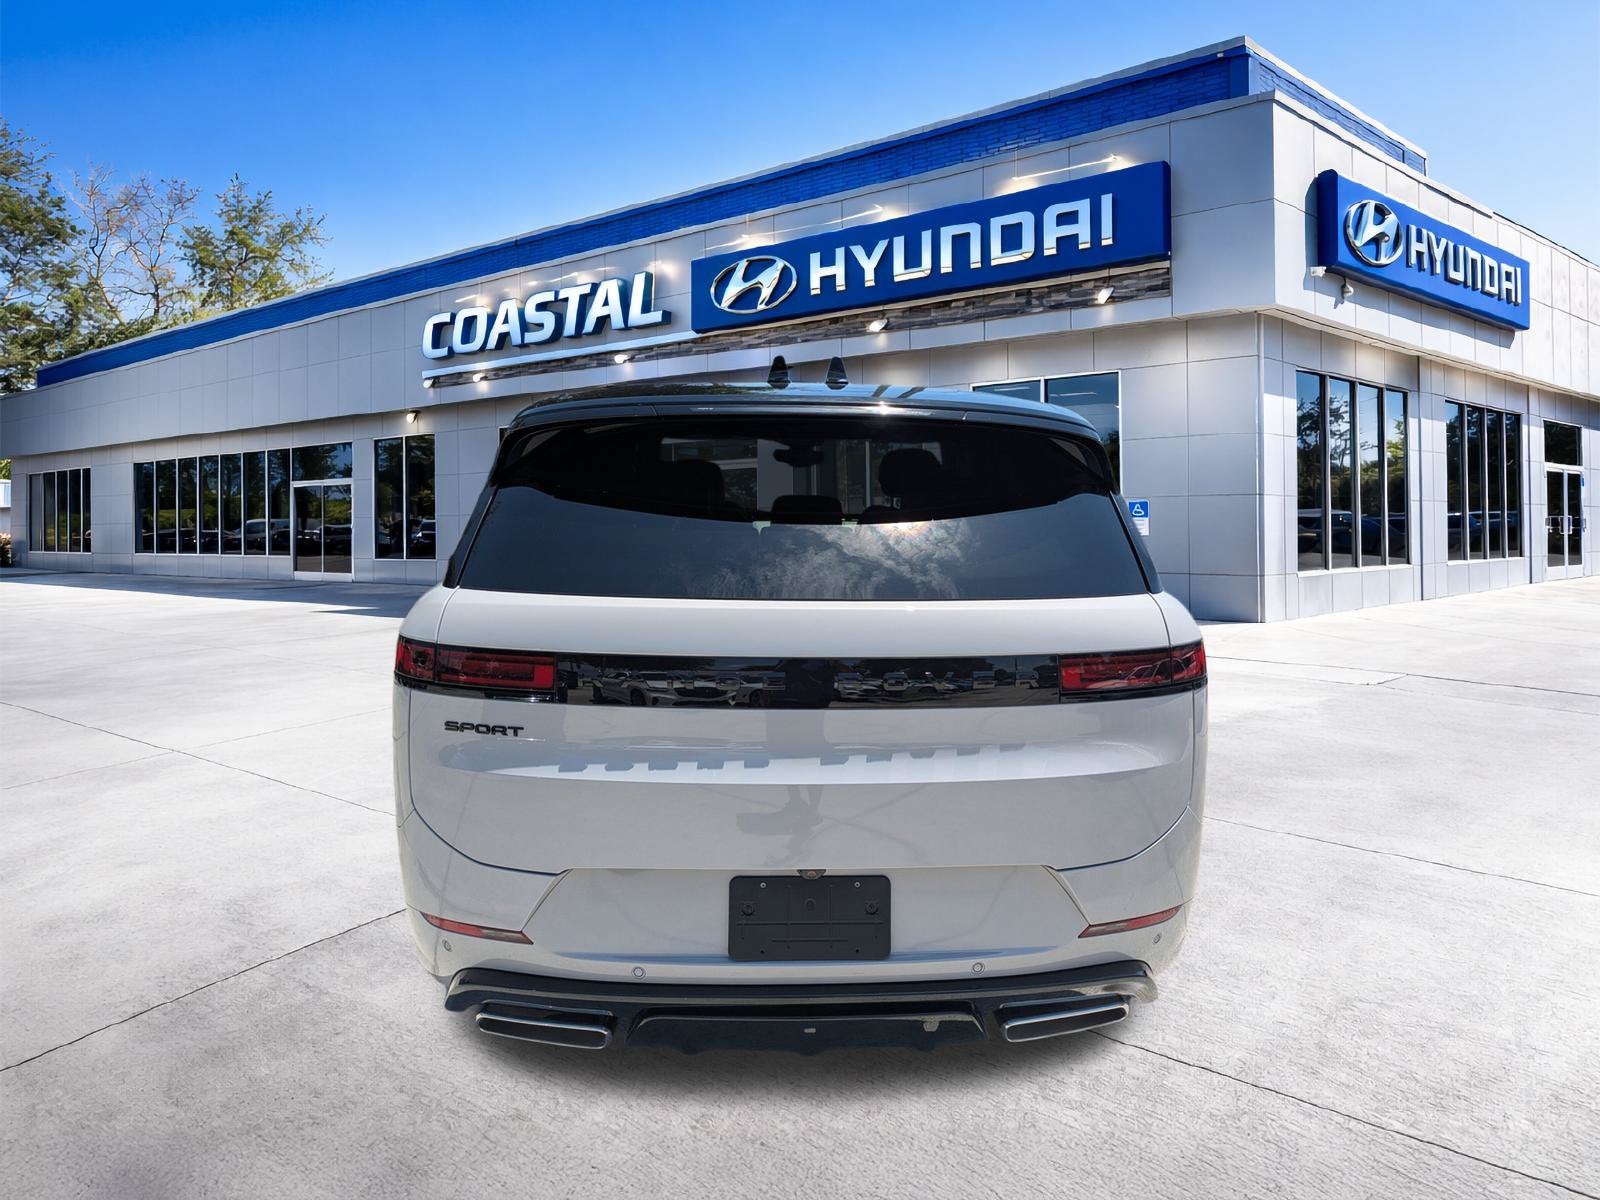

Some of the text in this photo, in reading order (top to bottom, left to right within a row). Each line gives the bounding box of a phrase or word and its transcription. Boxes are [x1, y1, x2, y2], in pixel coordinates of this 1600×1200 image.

[422, 192, 1114, 359] COASTAL HYUNDAI
[1406, 224, 1522, 306] HYUNDAI
[444, 720, 524, 737] SPORT
